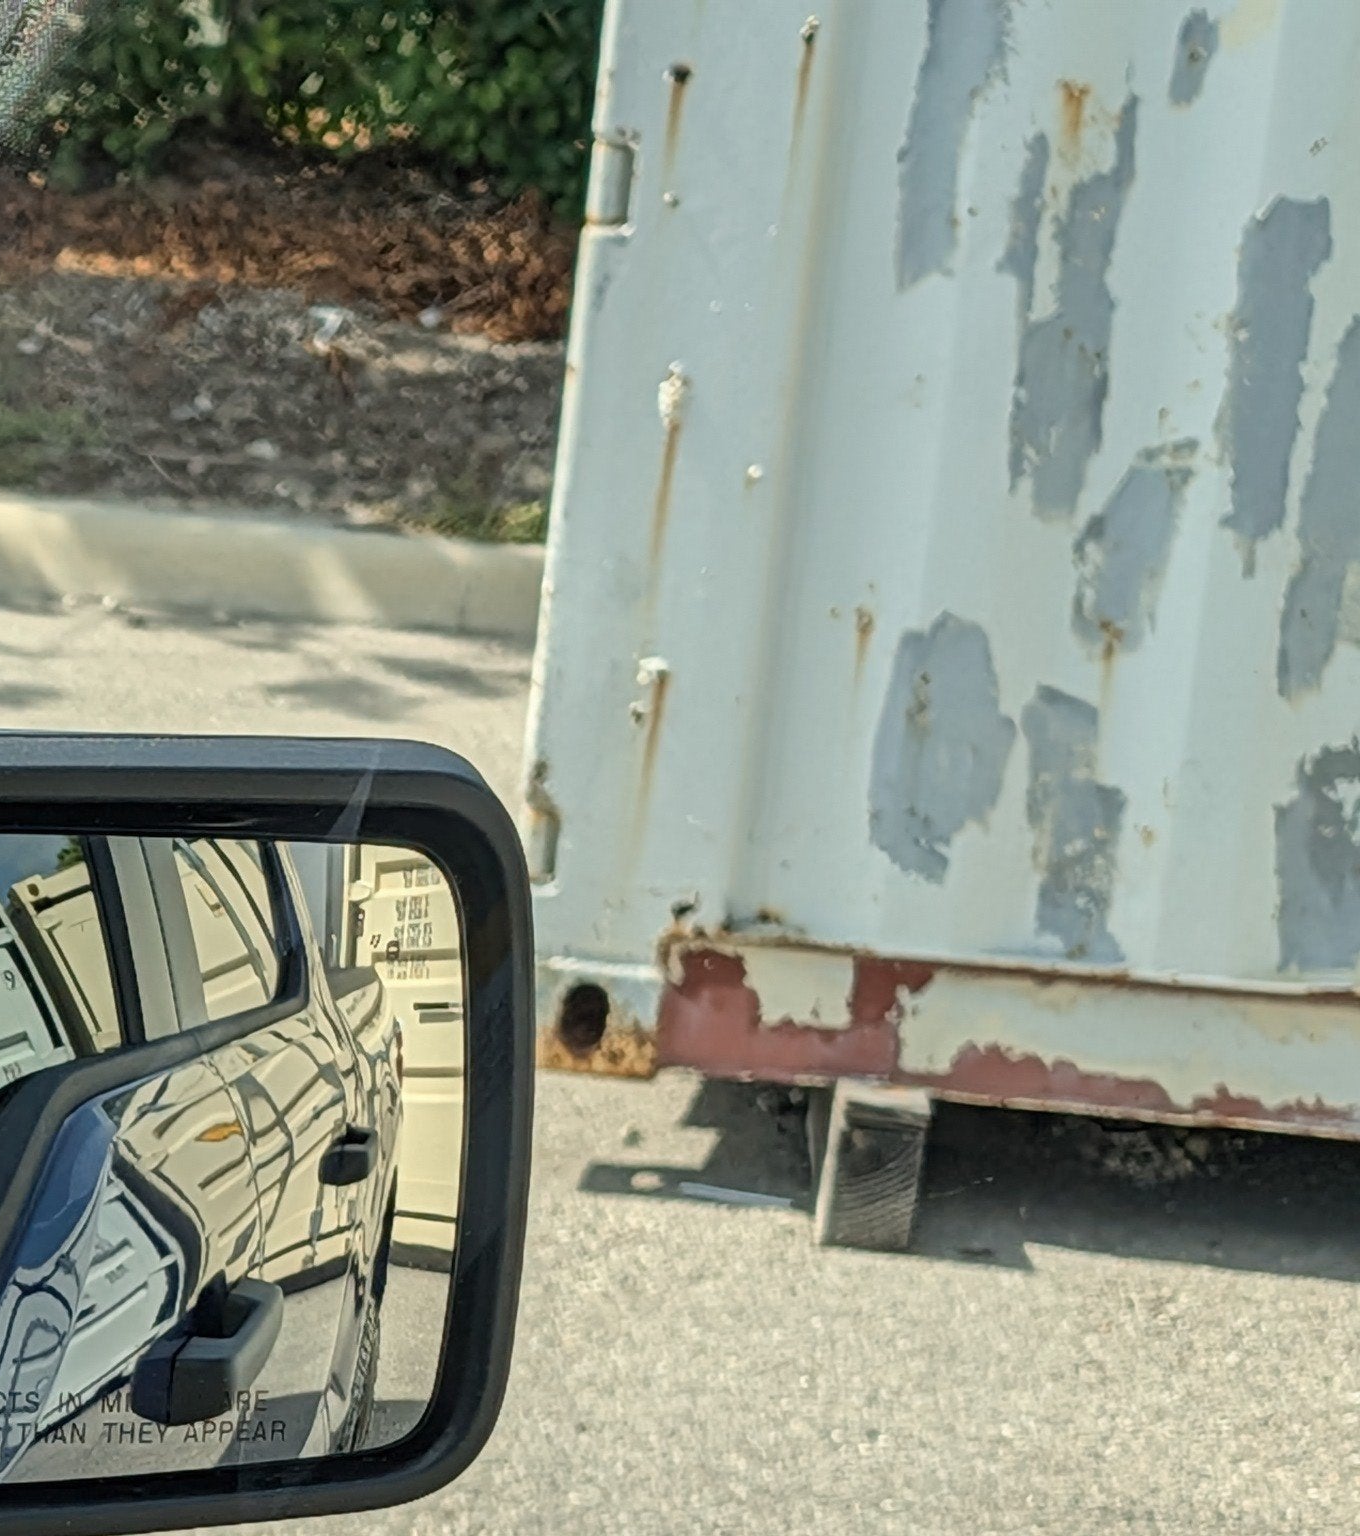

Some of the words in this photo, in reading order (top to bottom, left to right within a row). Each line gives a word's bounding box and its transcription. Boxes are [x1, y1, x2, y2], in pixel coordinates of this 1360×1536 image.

[3, 969, 17, 991] 9
[58, 1391, 82, 1413] IN
[17, 1422, 86, 1444] THAN
[102, 1421, 168, 1444] THEY
[183, 1420, 286, 1442] APPEAR
